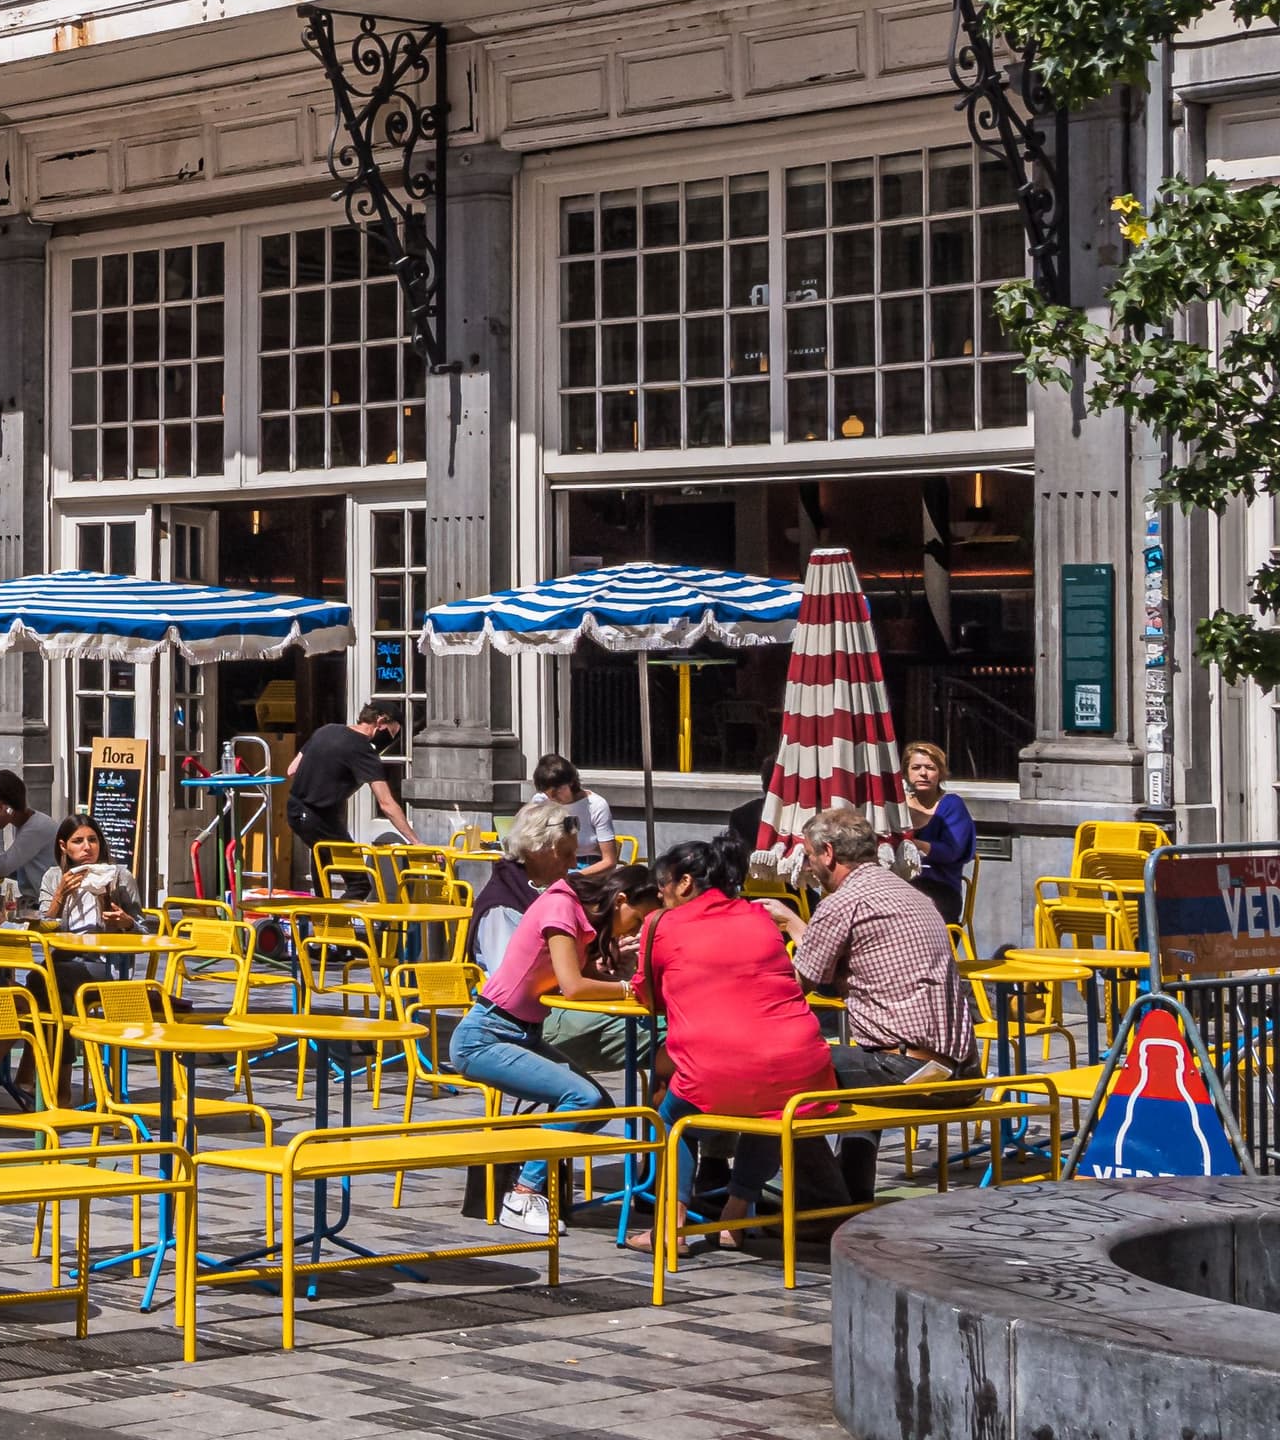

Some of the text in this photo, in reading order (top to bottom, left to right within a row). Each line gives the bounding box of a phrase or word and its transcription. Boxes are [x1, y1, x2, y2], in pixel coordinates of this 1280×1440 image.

[749, 284, 819, 306] flra
[102, 746, 134, 764] flora
[1218, 886, 1280, 940] VED
